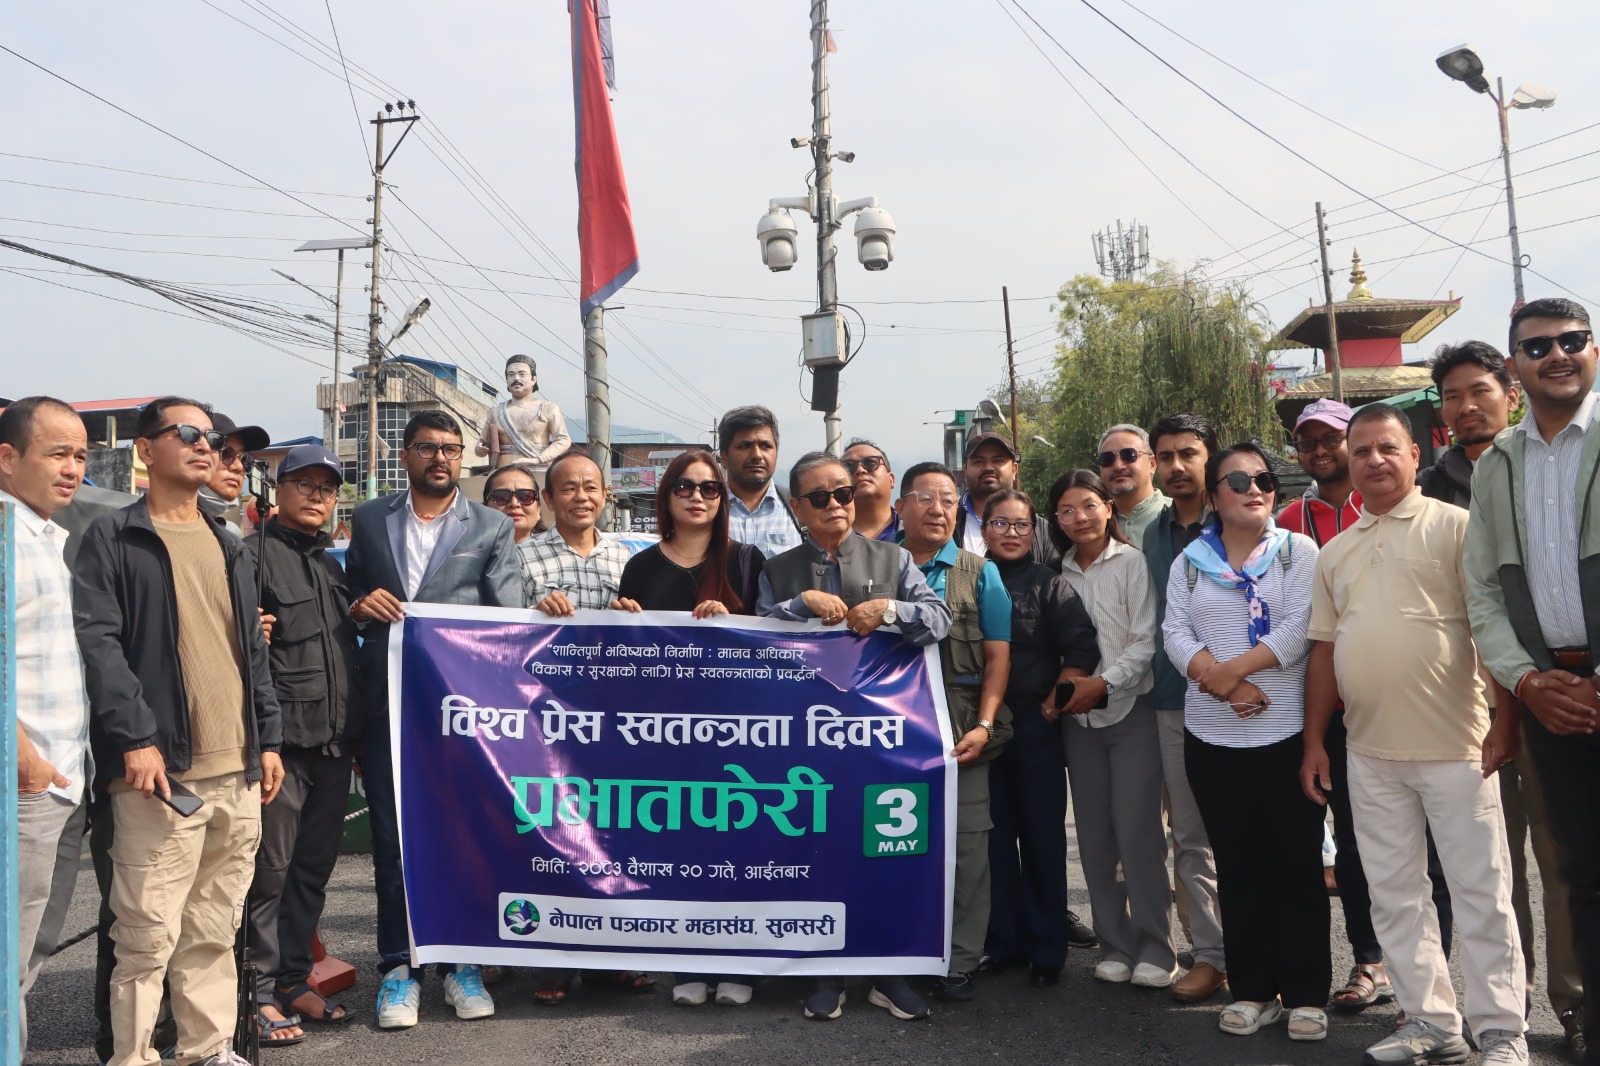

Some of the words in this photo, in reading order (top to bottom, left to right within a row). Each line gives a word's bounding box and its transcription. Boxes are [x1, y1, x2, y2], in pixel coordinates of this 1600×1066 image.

[605, 643, 661, 658] भविष्यको
[664, 643, 704, 659] निर्माण
[717, 647, 752, 659] मानव
[755, 646, 807, 662] अधिकार,
[531, 661, 573, 676] विकास
[576, 665, 585, 677] र
[588, 663, 638, 680] सुरक्षाको
[641, 664, 672, 678] लागि
[675, 663, 696, 679] प्रेस
[699, 665, 773, 680] स्वतन्त्रताको
[441, 695, 529, 741] विश्व
[541, 700, 605, 746] प्रेस
[616, 711, 794, 748] स्वतन्त्रता
[805, 704, 907, 750] दिवस
[510, 763, 834, 837] प्रभातफेरी
[874, 788, 918, 838] 3
[877, 839, 919, 853] MAY
[578, 860, 622, 877] २०८३
[627, 856, 675, 877] वैशाख
[679, 863, 703, 878] २०
[707, 860, 738, 881] गते,
[744, 860, 811, 881] आईतबार
[549, 907, 604, 931] नेपाल
[610, 916, 680, 934] पत्रकार
[685, 915, 758, 936] महासंघ,
[765, 914, 837, 939] सुनसरी
